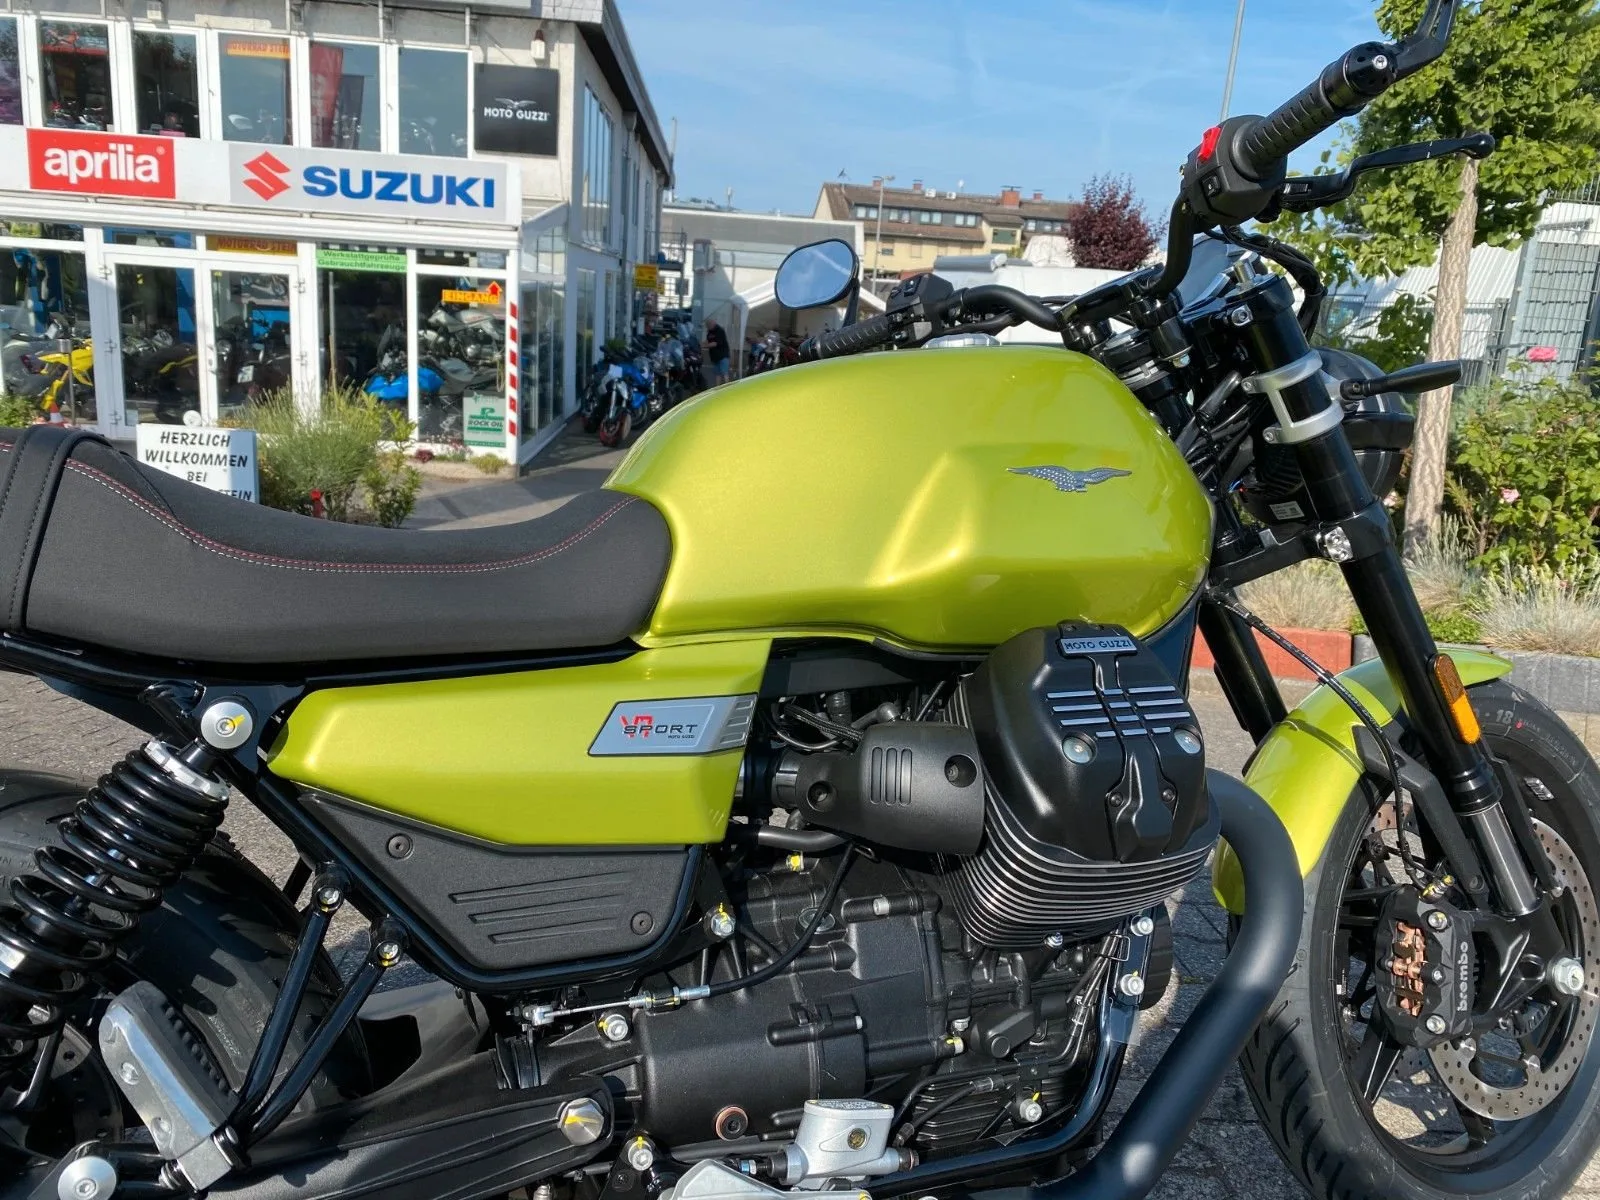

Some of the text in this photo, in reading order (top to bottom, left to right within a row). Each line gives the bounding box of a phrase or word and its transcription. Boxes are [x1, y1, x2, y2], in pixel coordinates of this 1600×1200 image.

[484, 107, 548, 121] MOTO GUZZI
[44, 142, 160, 185] aprilia
[302, 165, 496, 209] SUZUKI
[160, 431, 231, 448] HERZLICH
[145, 449, 248, 468] WILLKOMMEN
[187, 471, 207, 482] BEI
[1064, 639, 1132, 650] MOTO GUZZI
[623, 724, 698, 734] SPORT
[1457, 941, 1469, 1011] brembo
